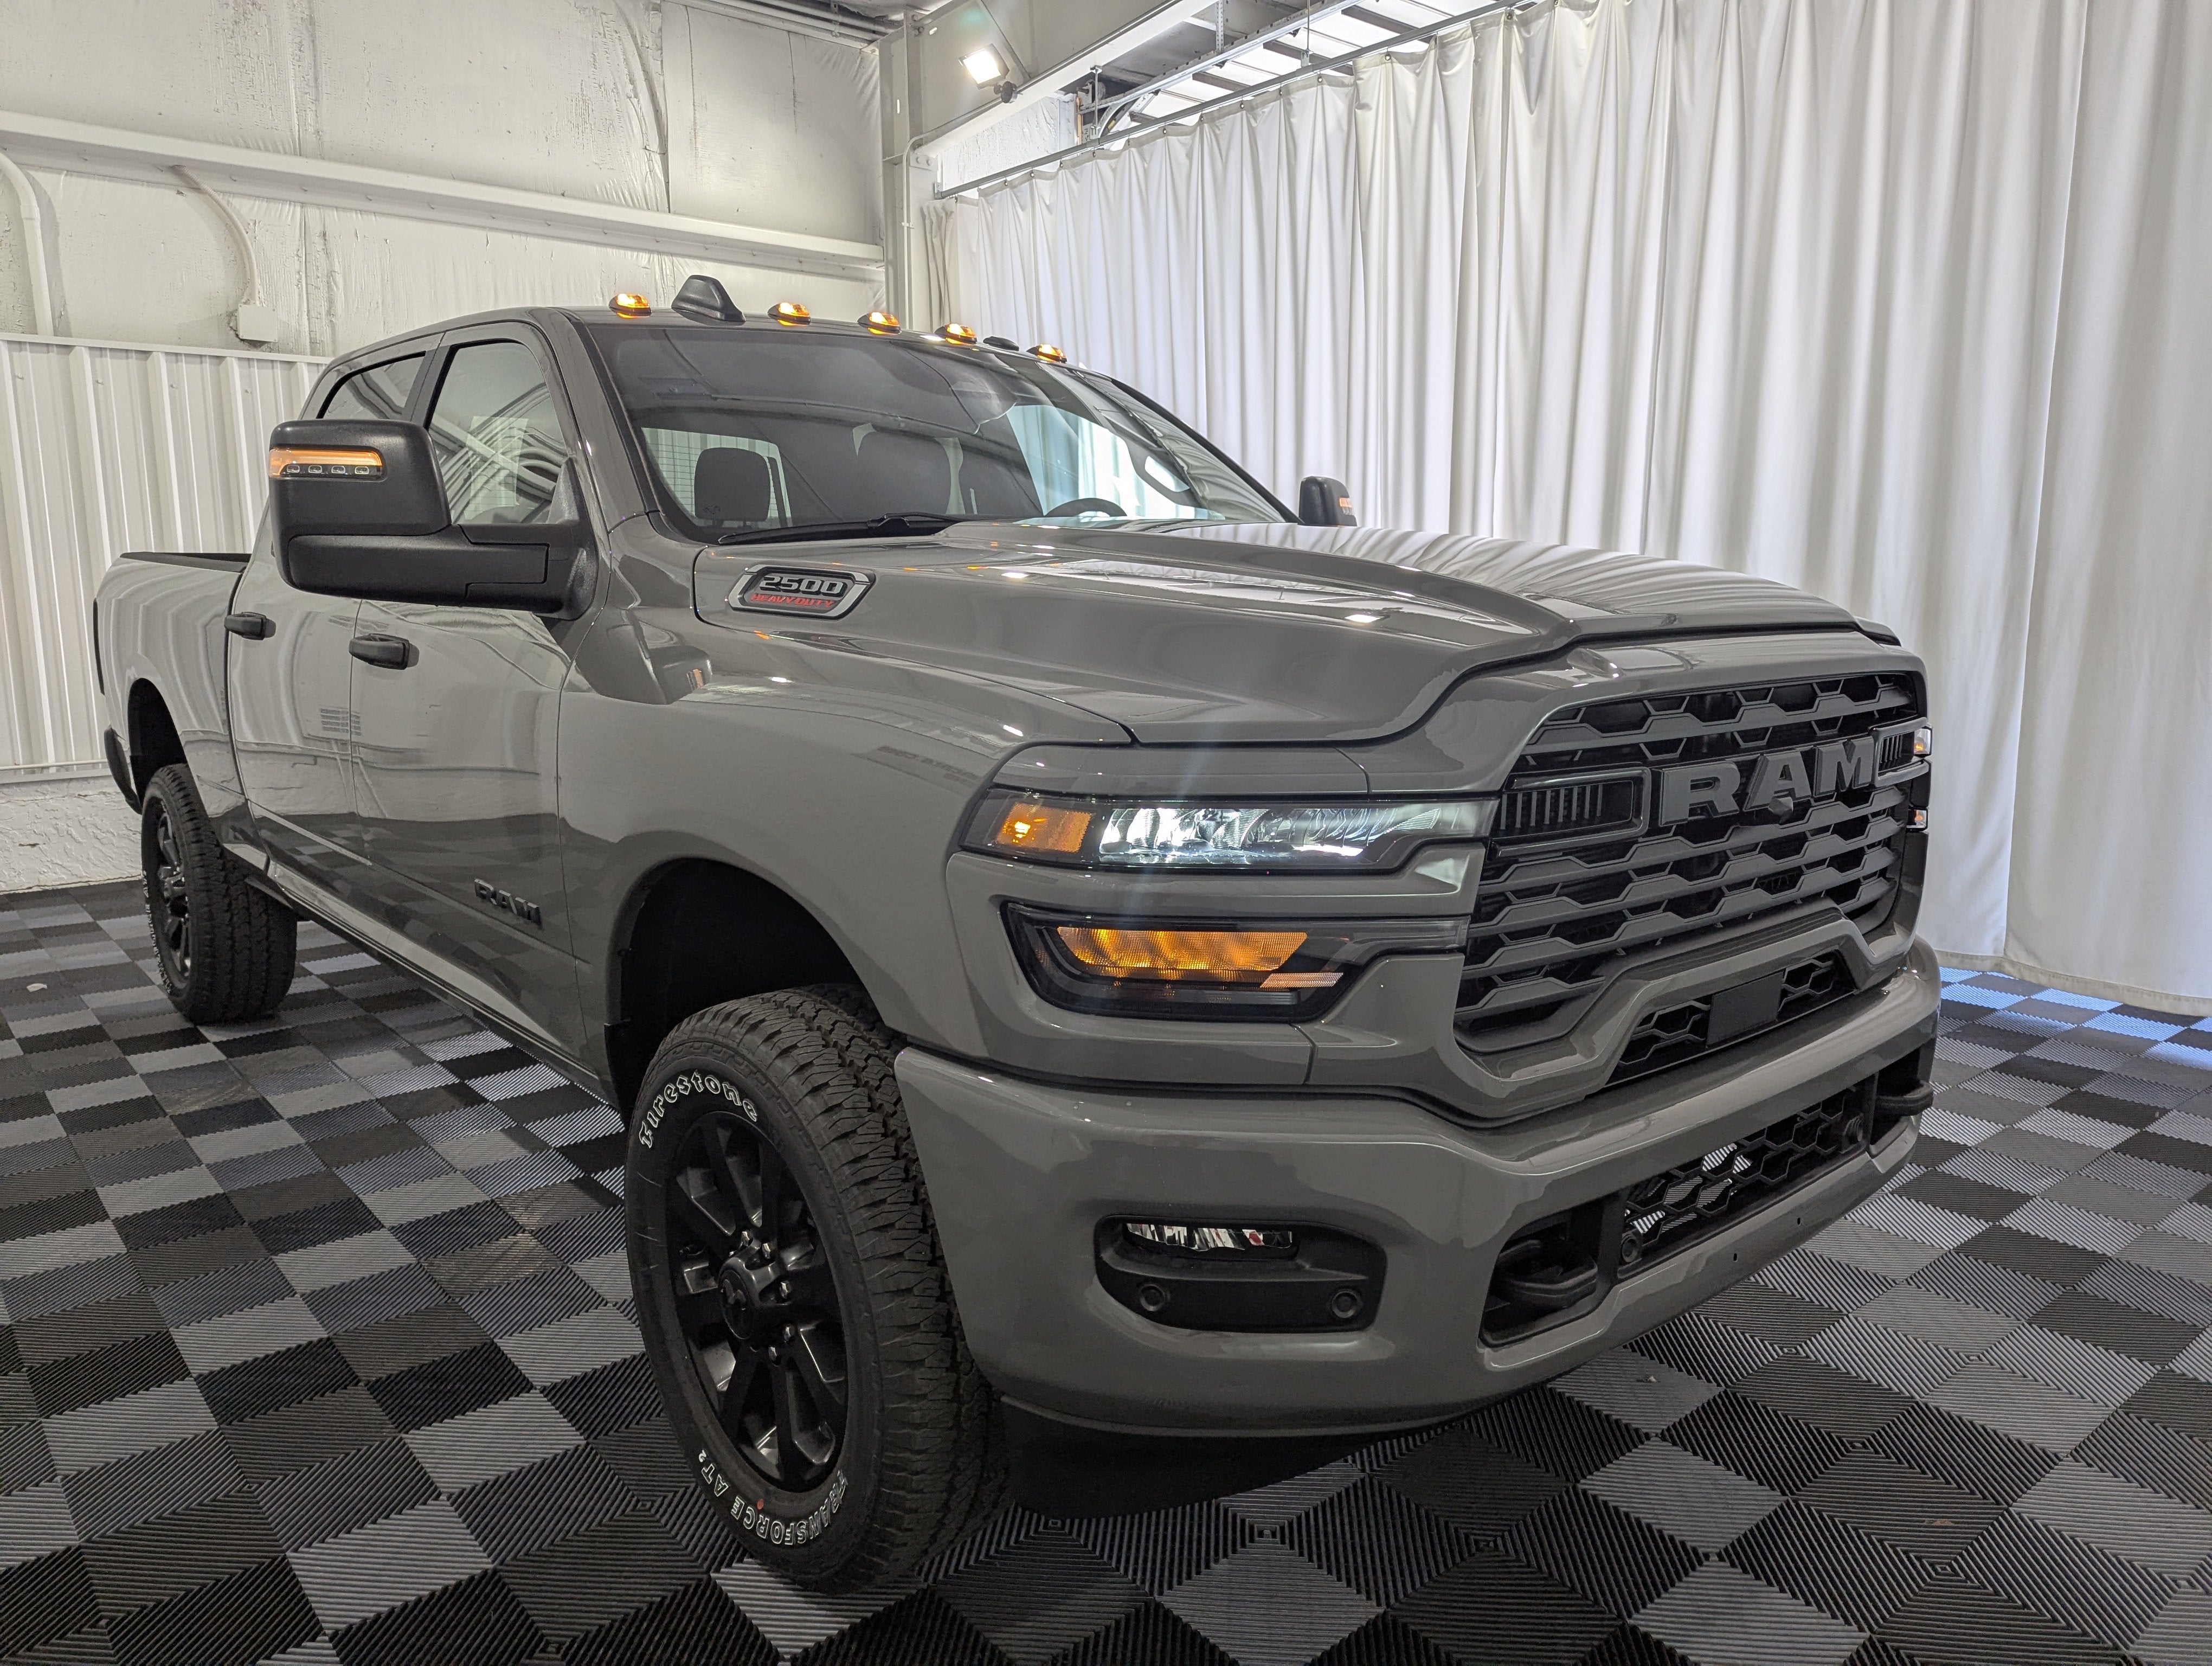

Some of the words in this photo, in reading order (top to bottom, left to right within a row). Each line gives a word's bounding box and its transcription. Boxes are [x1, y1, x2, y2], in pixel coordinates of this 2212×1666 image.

[751, 594, 795, 604] HEAVY
[795, 598, 834, 607] DUTY
[759, 575, 847, 597] 2500
[1660, 736, 1874, 826] RAM
[474, 877, 542, 925] RAM
[639, 1070, 757, 1148] Firestone
[731, 1470, 848, 1545] TRANSFORCE
